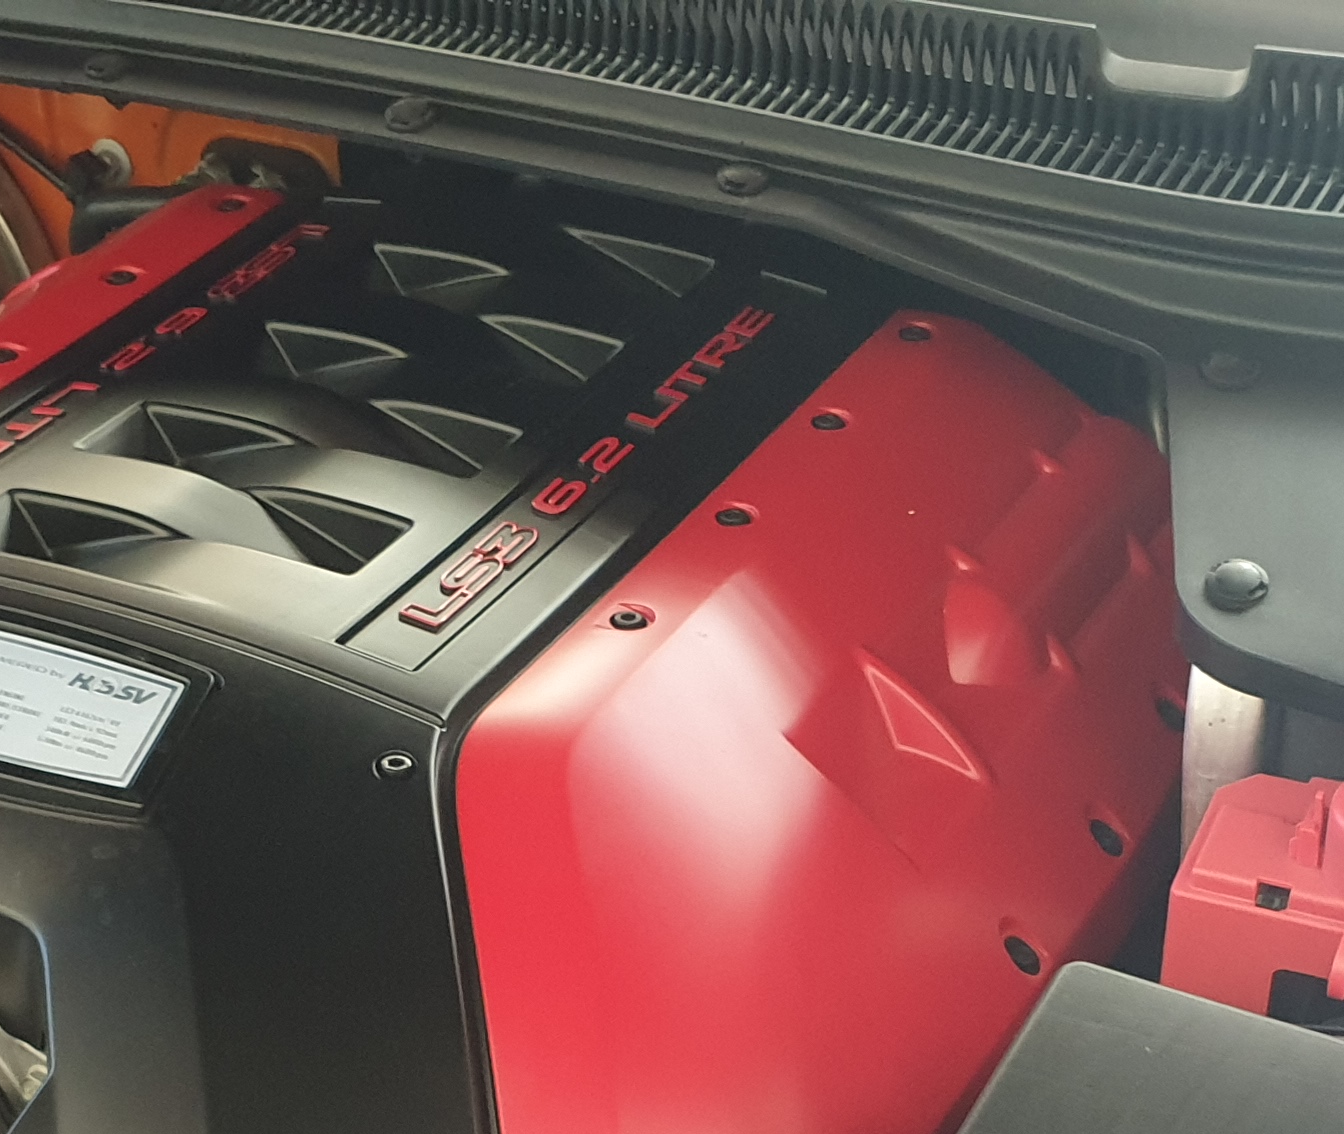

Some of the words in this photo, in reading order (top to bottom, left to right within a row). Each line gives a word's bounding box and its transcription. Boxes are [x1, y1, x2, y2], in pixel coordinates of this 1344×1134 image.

[398, 520, 538, 633] LS3
[531, 436, 635, 515] 6.2
[626, 305, 776, 431] LITRE
